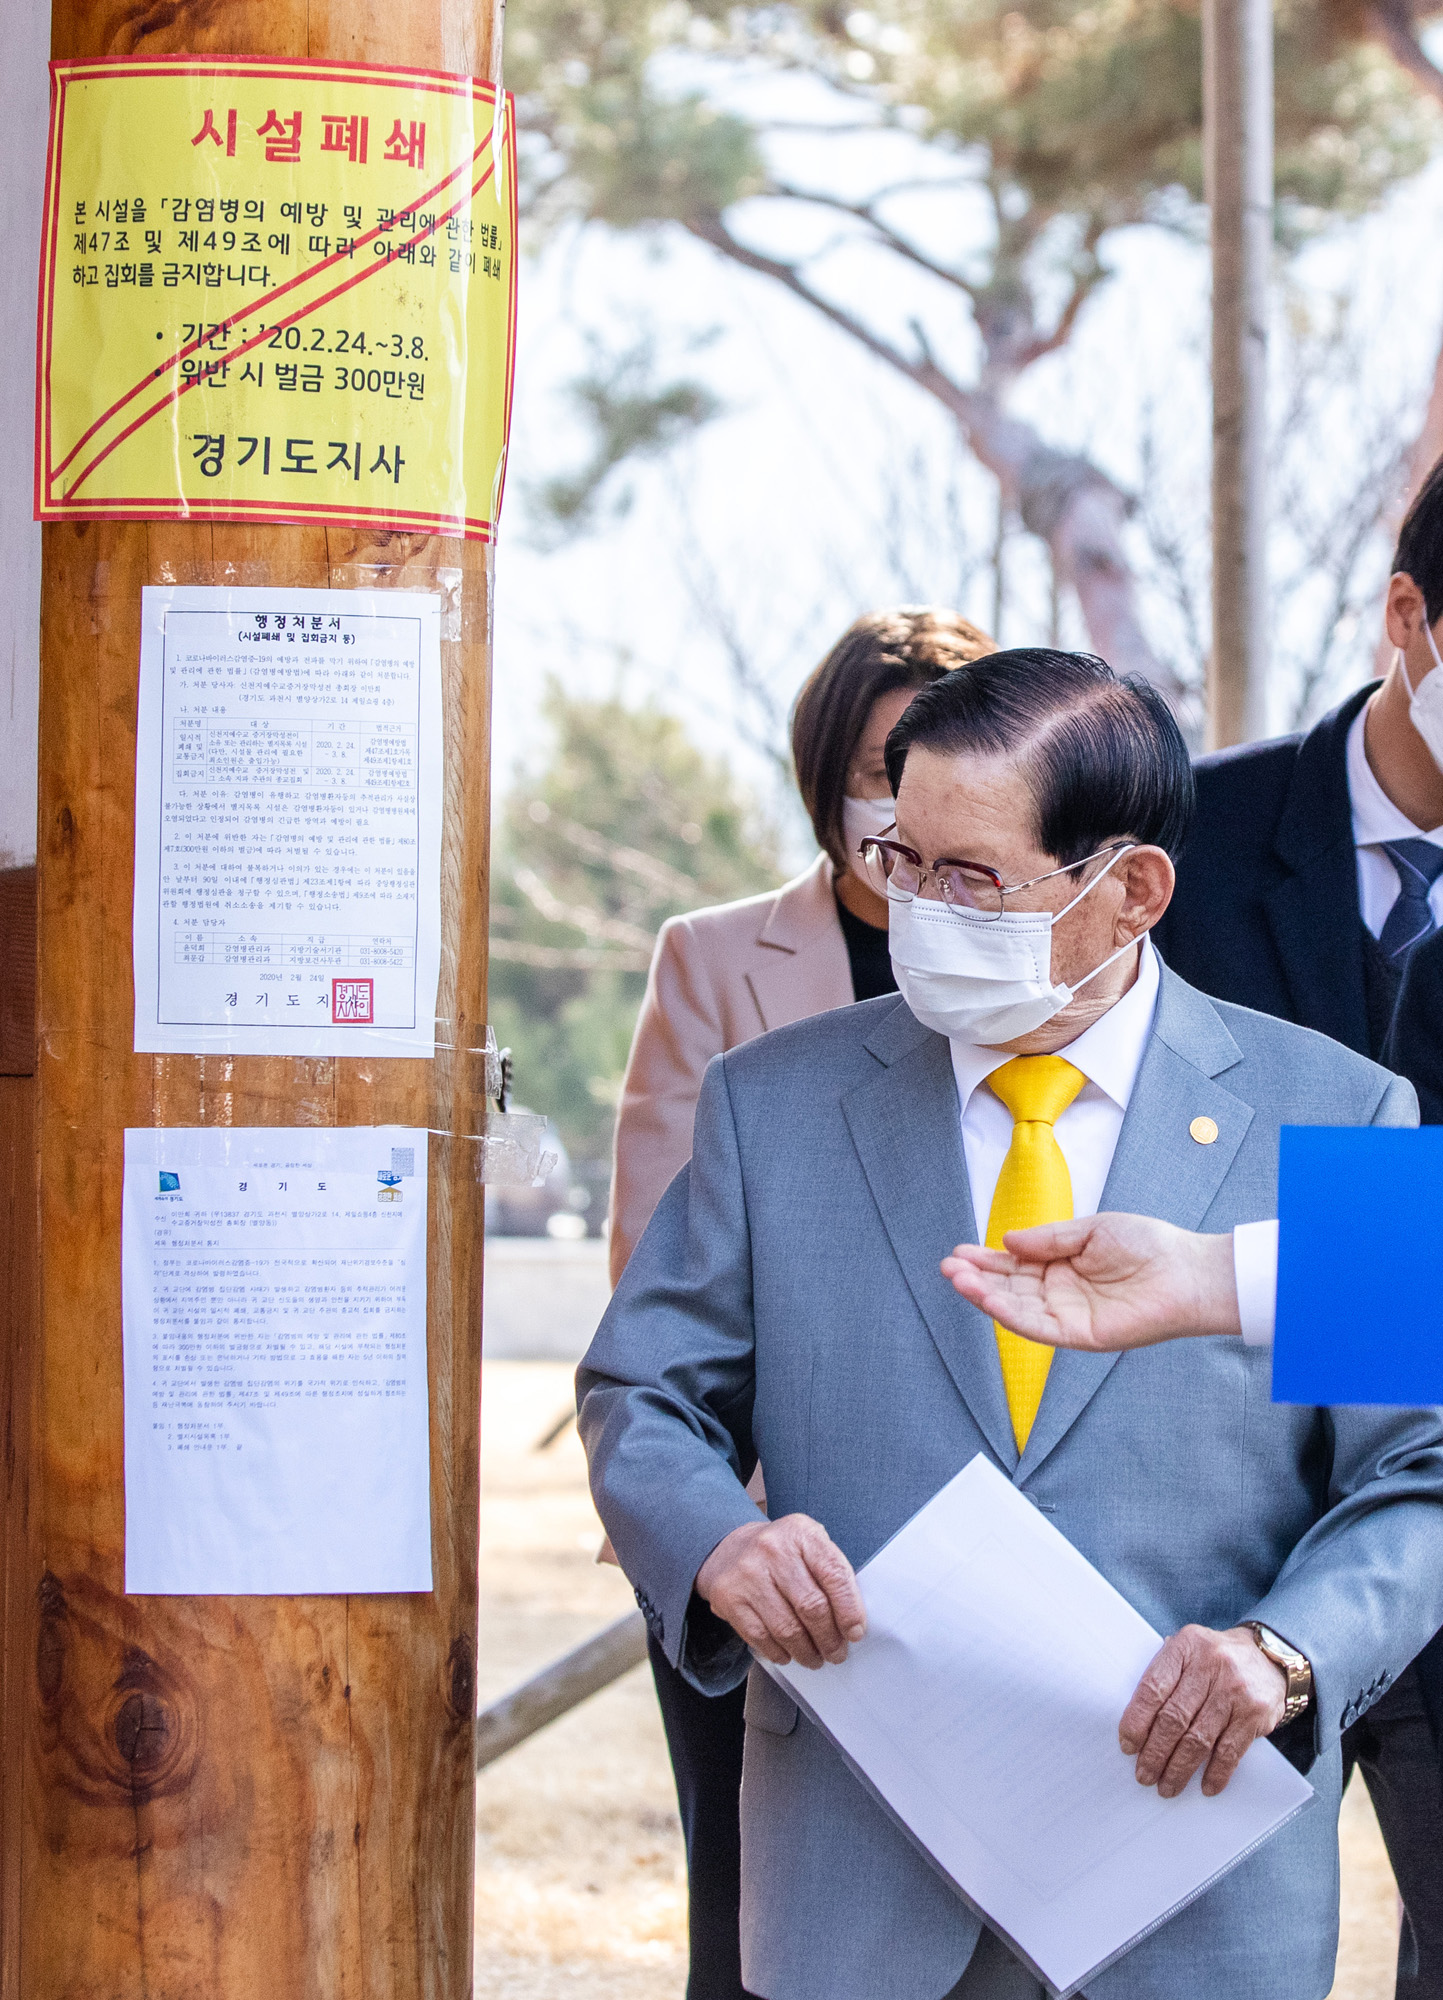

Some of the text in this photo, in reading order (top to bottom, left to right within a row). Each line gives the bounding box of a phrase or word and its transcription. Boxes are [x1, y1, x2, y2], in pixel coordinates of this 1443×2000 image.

[190, 108, 427, 170] 시설폐쇄
[74, 200, 87, 225] 본
[95, 198, 148, 223] 시설을
[280, 200, 328, 226] 예방
[344, 206, 363, 229] 및
[376, 207, 435, 235] 관리에
[445, 216, 473, 243] 관한
[72, 262, 277, 288] 하고 집회를 금지합니다.
[74, 231, 501, 282] 제47조 및 제49조에 따라 아래와 같이 폐쇄
[182, 322, 231, 351] 기간
[180, 360, 426, 401] 위반 시 벌금 300만원
[192, 433, 406, 483] 경기도지사
[238, 631, 355, 645] (시설폐쇄 및 집회금지 등)
[255, 614, 341, 630] 행정처분서
